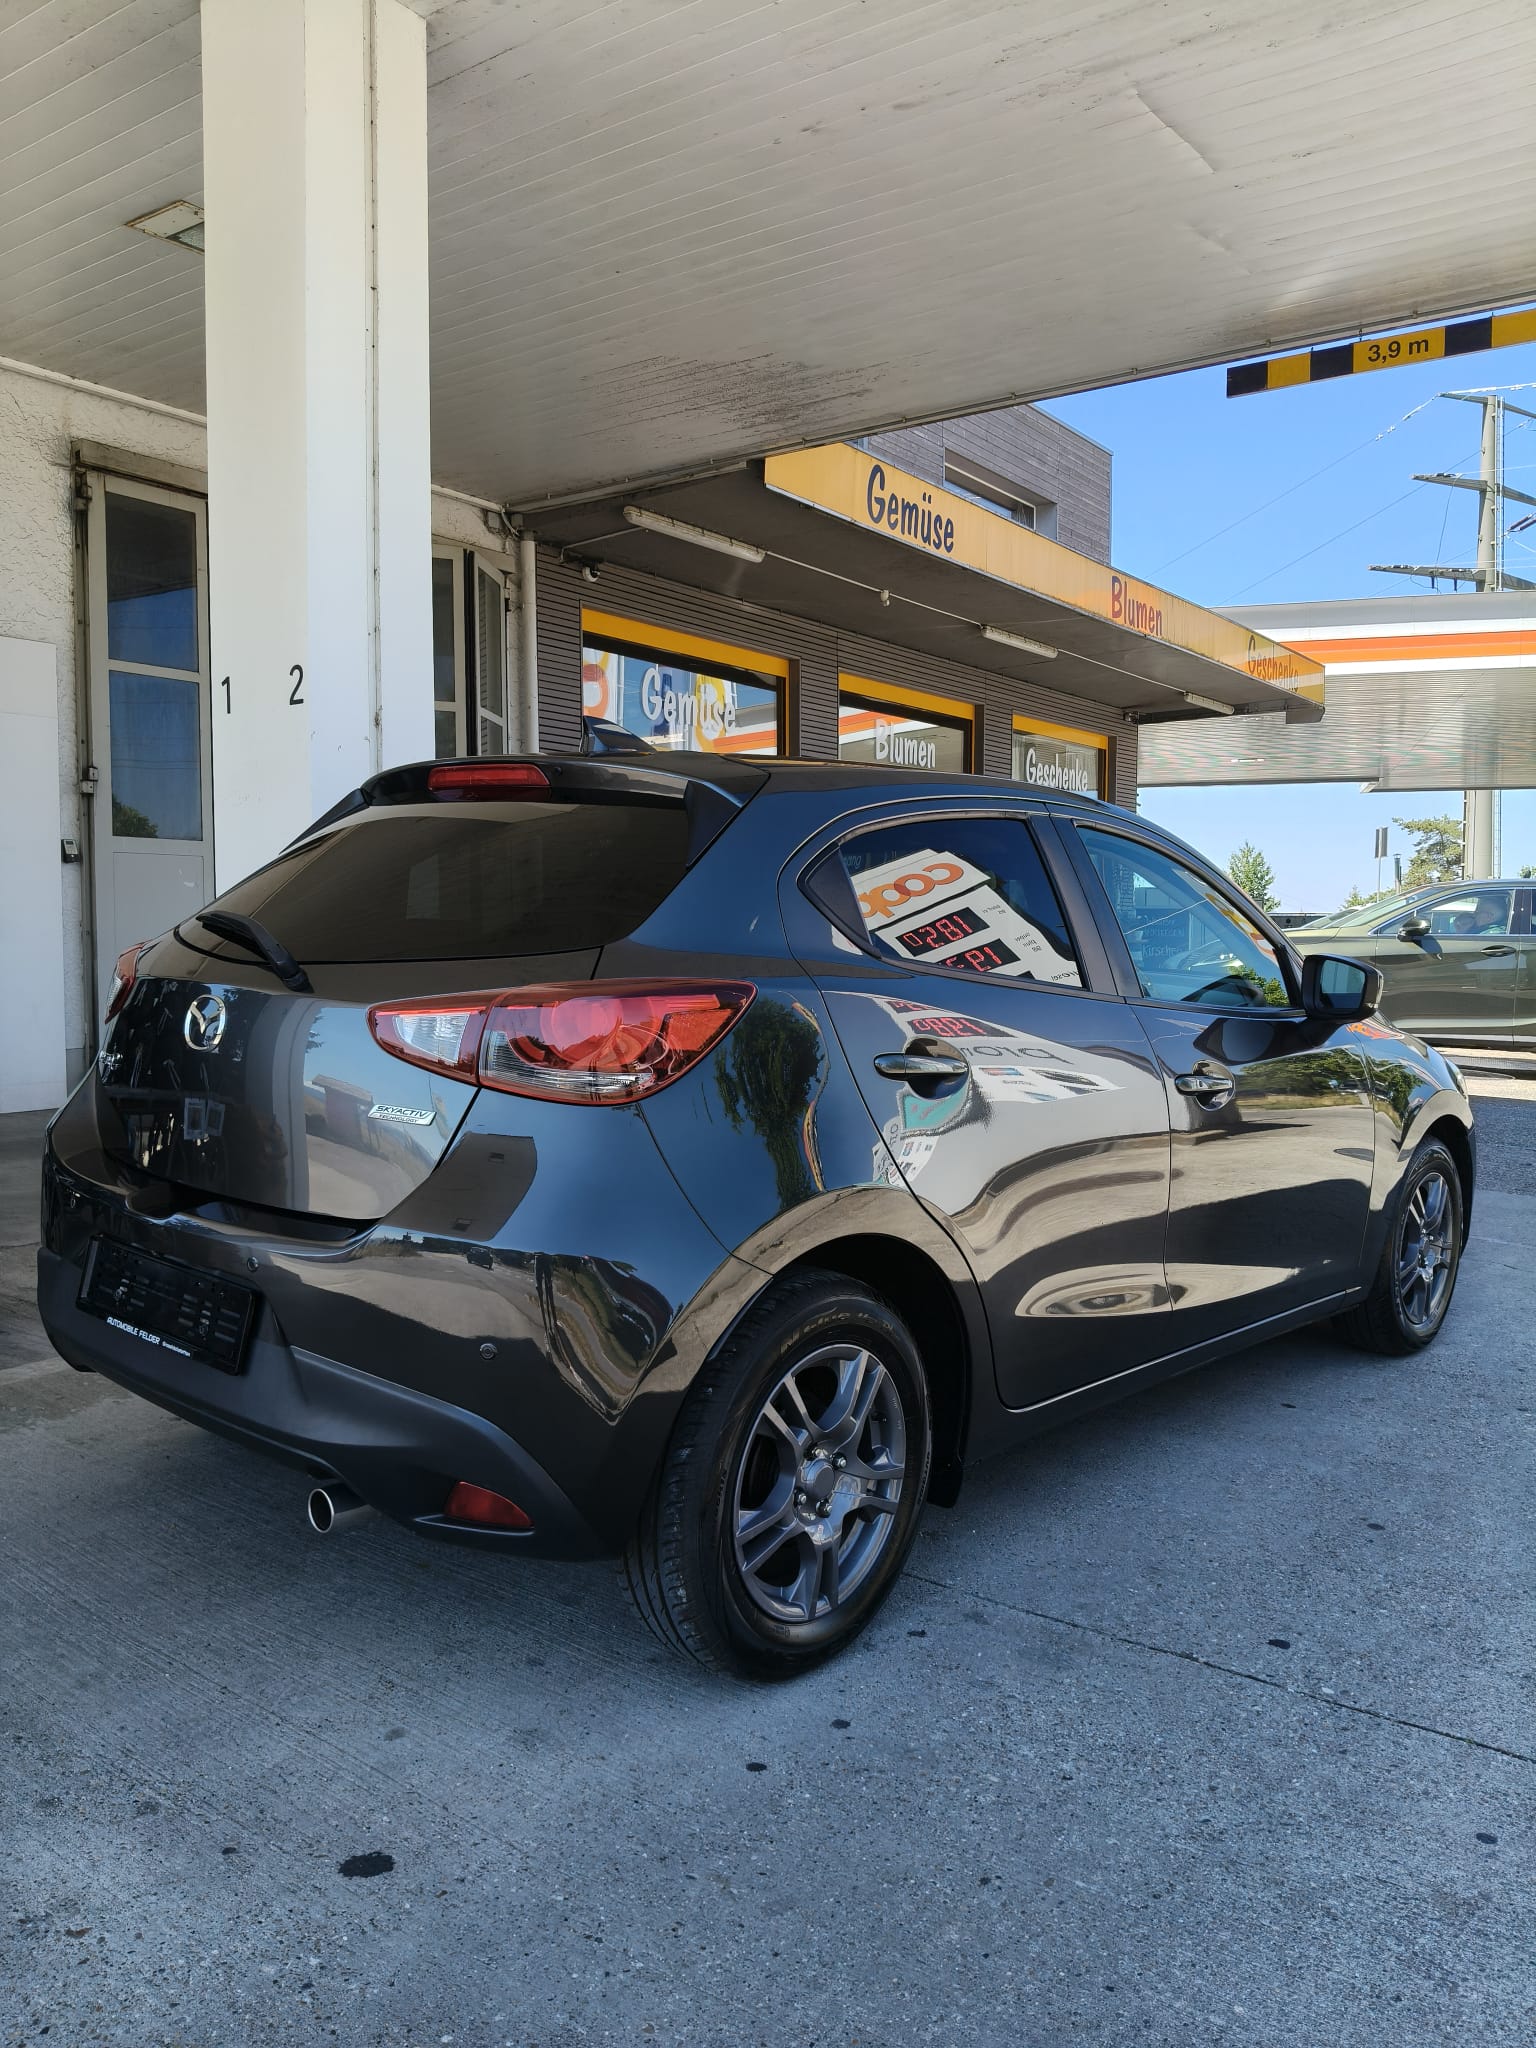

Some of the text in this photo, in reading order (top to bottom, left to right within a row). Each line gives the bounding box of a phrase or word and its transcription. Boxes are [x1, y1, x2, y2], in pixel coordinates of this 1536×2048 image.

[1368, 338, 1430, 364] 3,9 m
[867, 464, 954, 554] Gemüse
[1111, 575, 1163, 637] Blumen
[289, 664, 304, 706] 2
[1247, 634, 1300, 693] Geschenke
[221, 675, 231, 714] 1
[641, 666, 736, 732] Gemüse
[875, 718, 936, 769] Blumen
[1025, 747, 1089, 792] Geschenke
[375, 1105, 428, 1117] SKYACTIV
[106, 1316, 161, 1345] AUTOMOBILE FELDER
